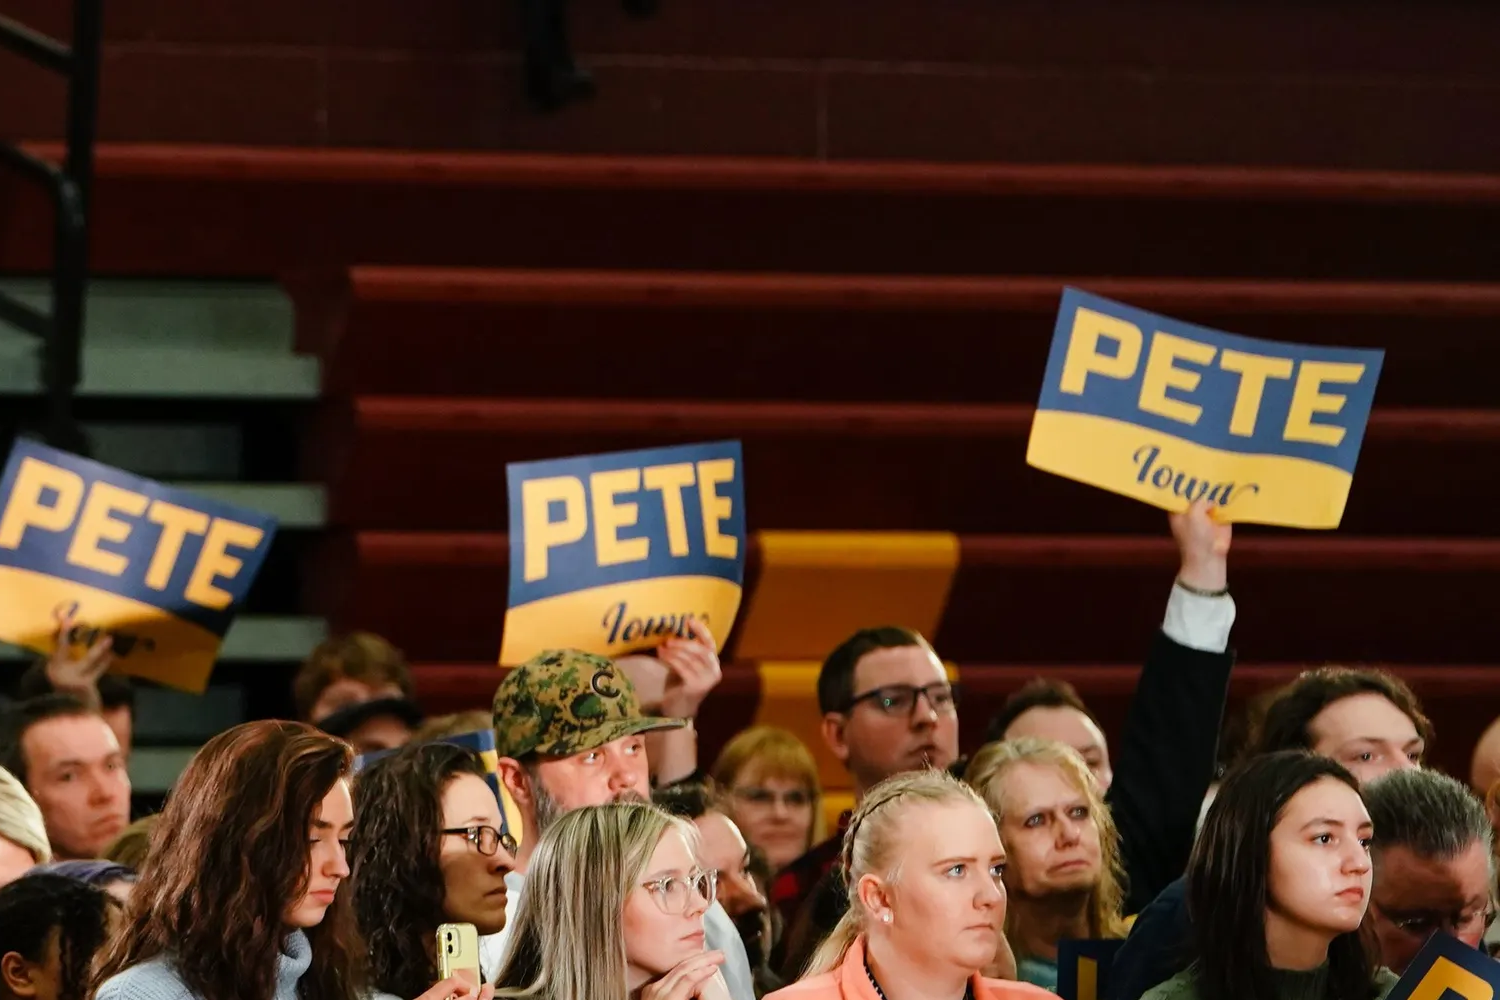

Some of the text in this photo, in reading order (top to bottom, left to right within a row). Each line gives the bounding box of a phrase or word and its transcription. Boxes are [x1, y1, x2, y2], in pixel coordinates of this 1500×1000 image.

[1060, 306, 1366, 447] PETE
[522, 458, 739, 582] PETE
[1133, 444, 1260, 506] Iowa
